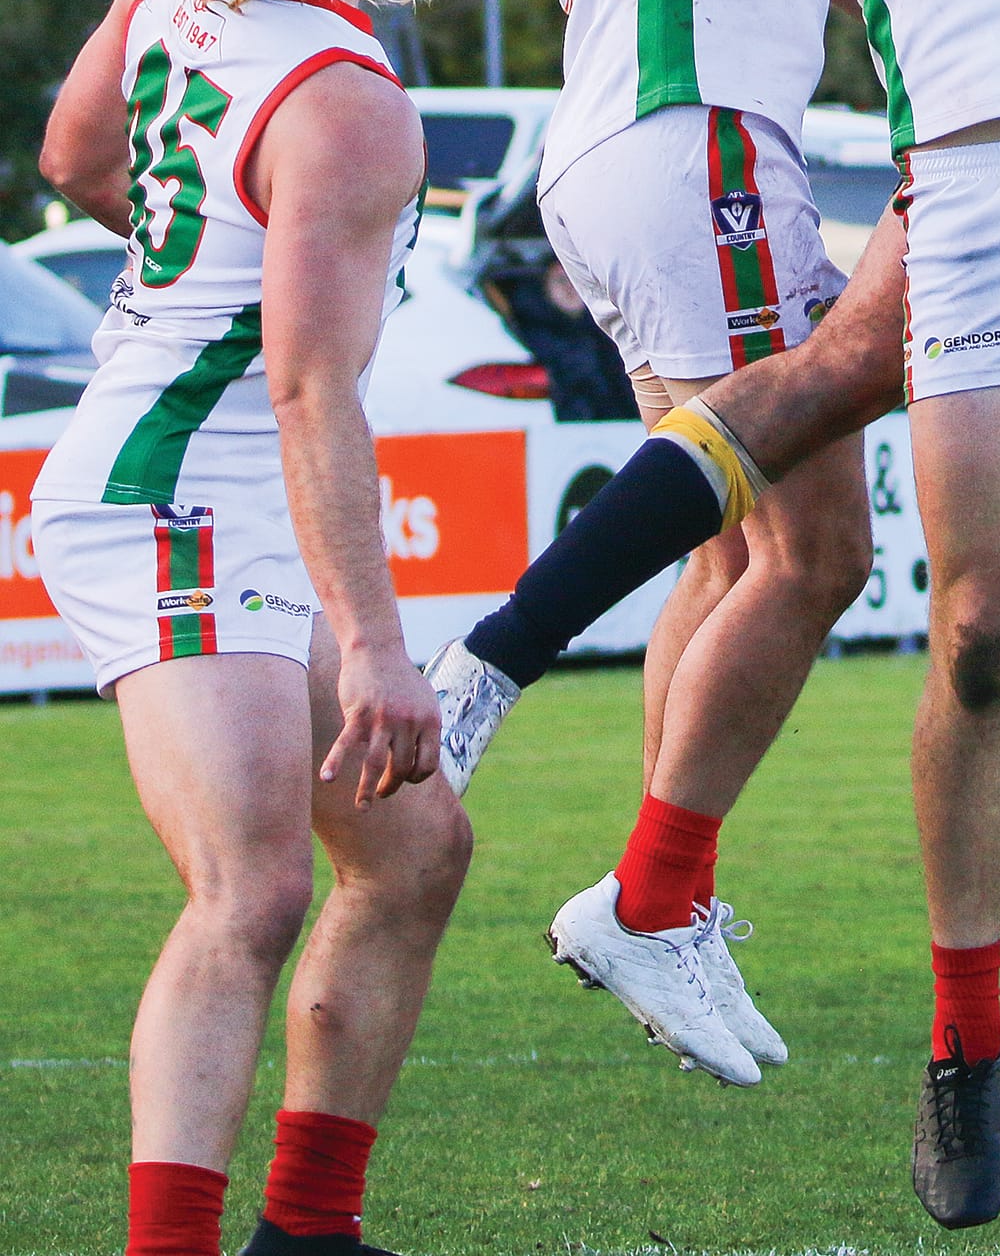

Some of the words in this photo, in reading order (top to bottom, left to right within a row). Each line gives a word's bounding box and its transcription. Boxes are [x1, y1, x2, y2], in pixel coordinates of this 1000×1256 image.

[186, 22, 217, 52] 1947
[728, 191, 745, 199] AFL
[727, 232, 756, 242] COUNTRY
[168, 518, 201, 528] COUNTRY
